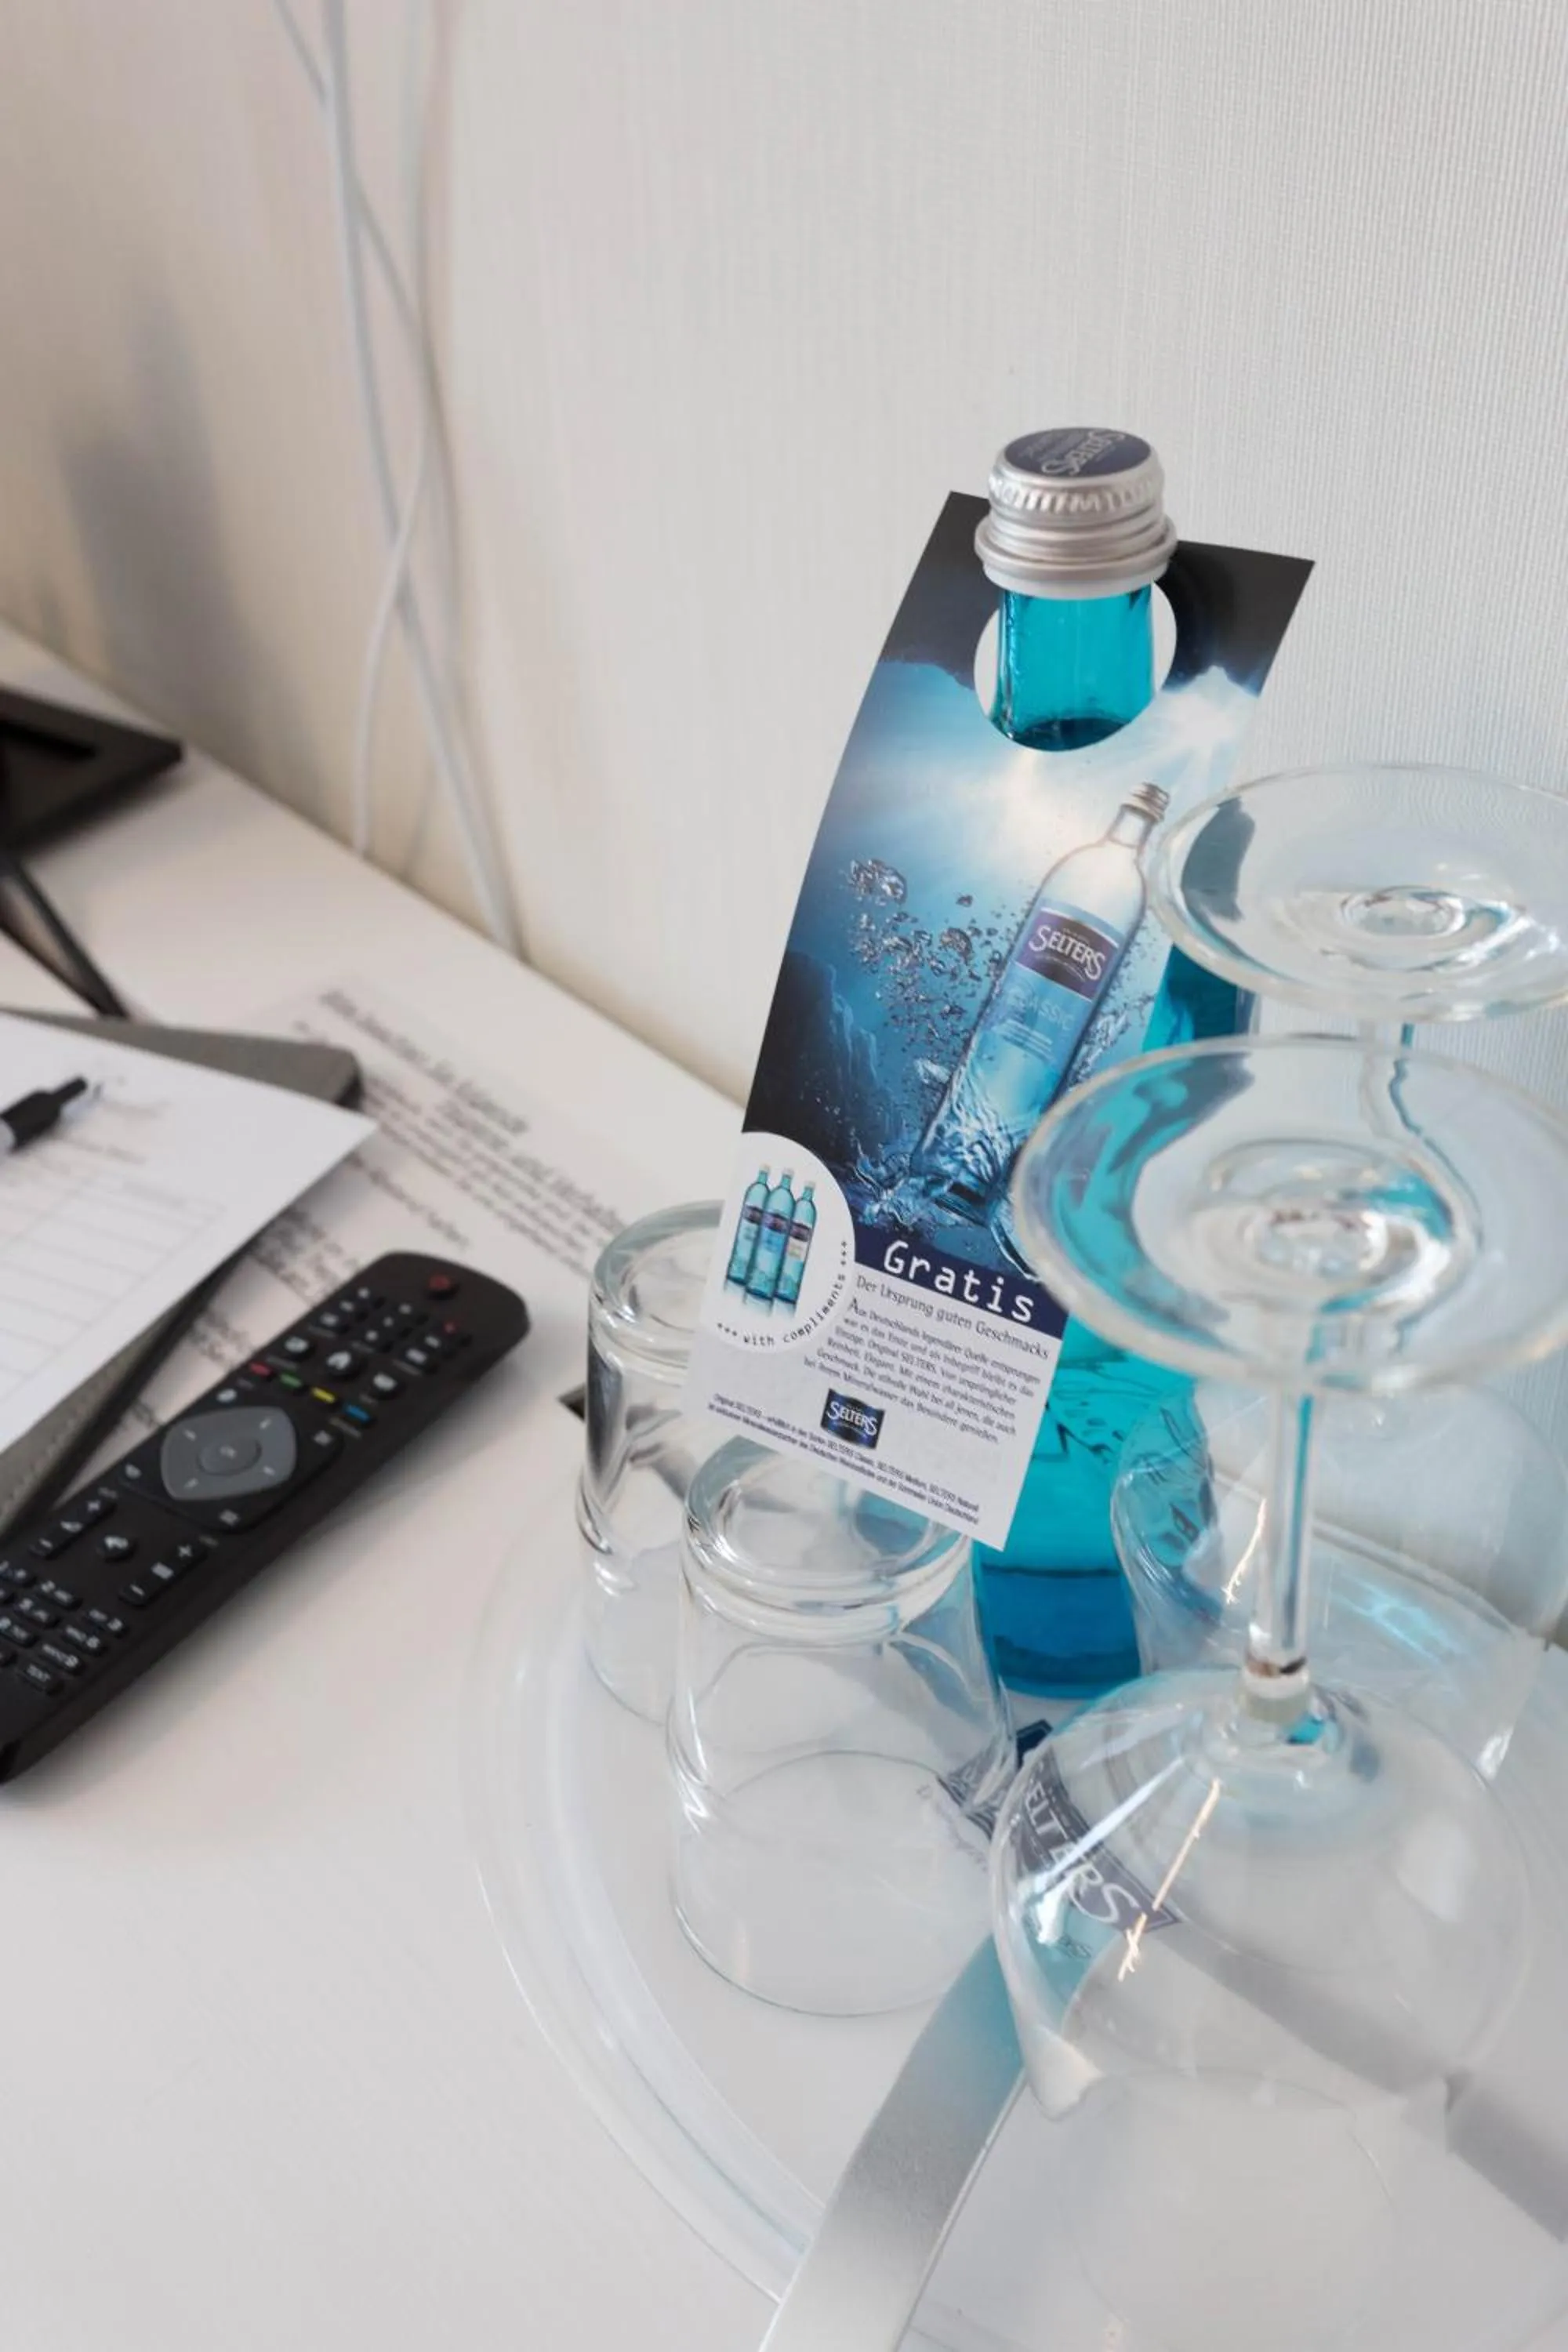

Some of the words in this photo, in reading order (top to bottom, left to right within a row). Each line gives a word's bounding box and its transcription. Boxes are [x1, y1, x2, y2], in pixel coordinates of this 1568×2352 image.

[1029, 925, 1105, 979] SELTERS
[743, 1334, 775, 1347] with
[782, 1273, 846, 1344] compliments
[855, 1273, 879, 1294] Der
[880, 1283, 935, 1319] Ursprung
[935, 1308, 973, 1330] guten
[975, 1319, 1050, 1361] Geschmacks
[884, 1240, 1035, 1322] Gratis
[826, 1400, 877, 1436] SELTERS
